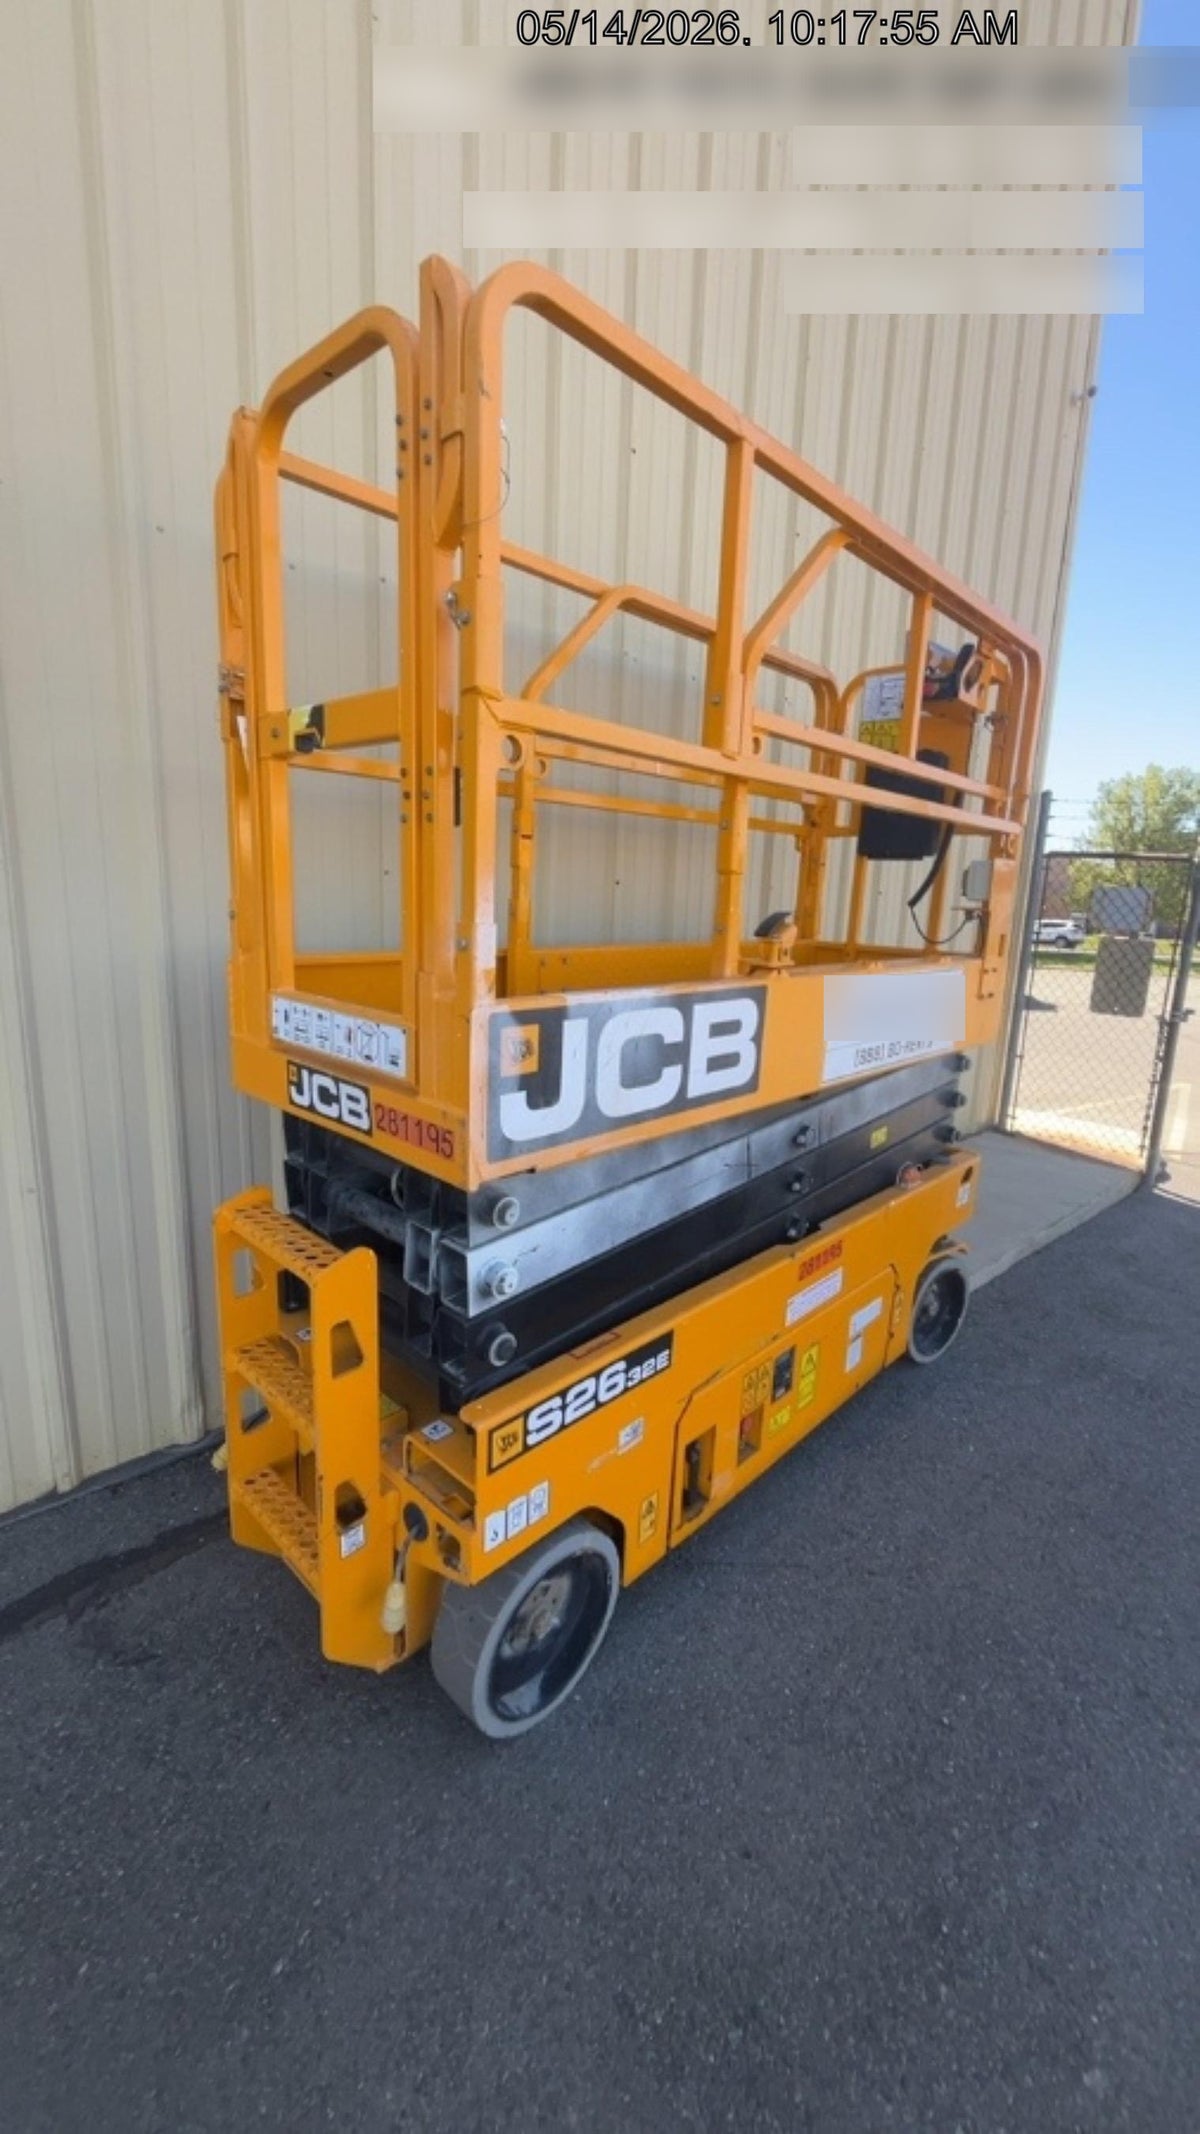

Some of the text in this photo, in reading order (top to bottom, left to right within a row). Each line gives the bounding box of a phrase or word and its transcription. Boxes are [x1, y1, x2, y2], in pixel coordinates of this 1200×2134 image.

[290, 1068, 372, 1132] JCB
[498, 998, 759, 1141] JCB
[374, 1103, 455, 1158] 281195
